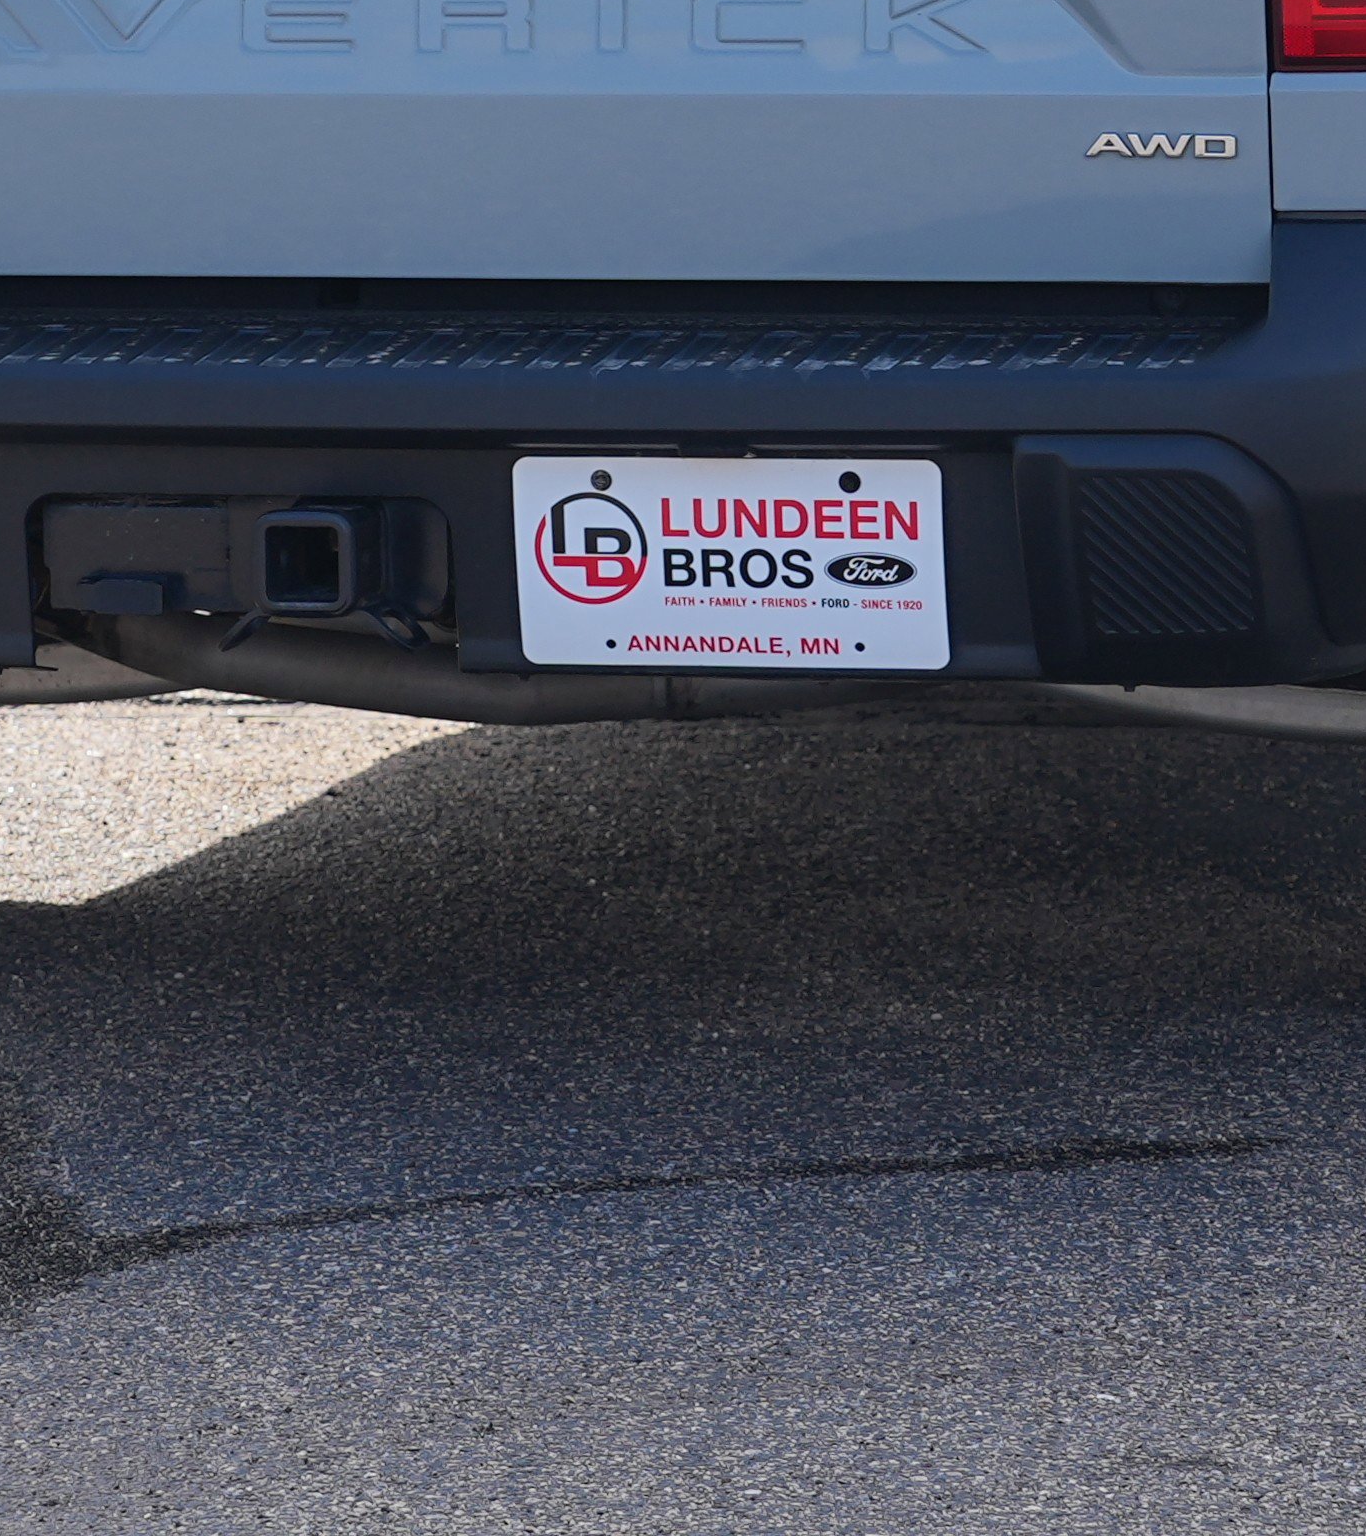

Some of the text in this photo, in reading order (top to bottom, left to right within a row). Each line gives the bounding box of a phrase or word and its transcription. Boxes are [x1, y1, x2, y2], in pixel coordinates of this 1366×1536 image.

[1085, 131, 1237, 158] AWD
[661, 497, 919, 541] LUNDEEN
[664, 548, 899, 589] BROS Ford
[664, 596, 923, 611] FAITH FAMILY FRIENDS FORD SINCE 1920
[627, 634, 840, 658] ANNANDALE, MN
